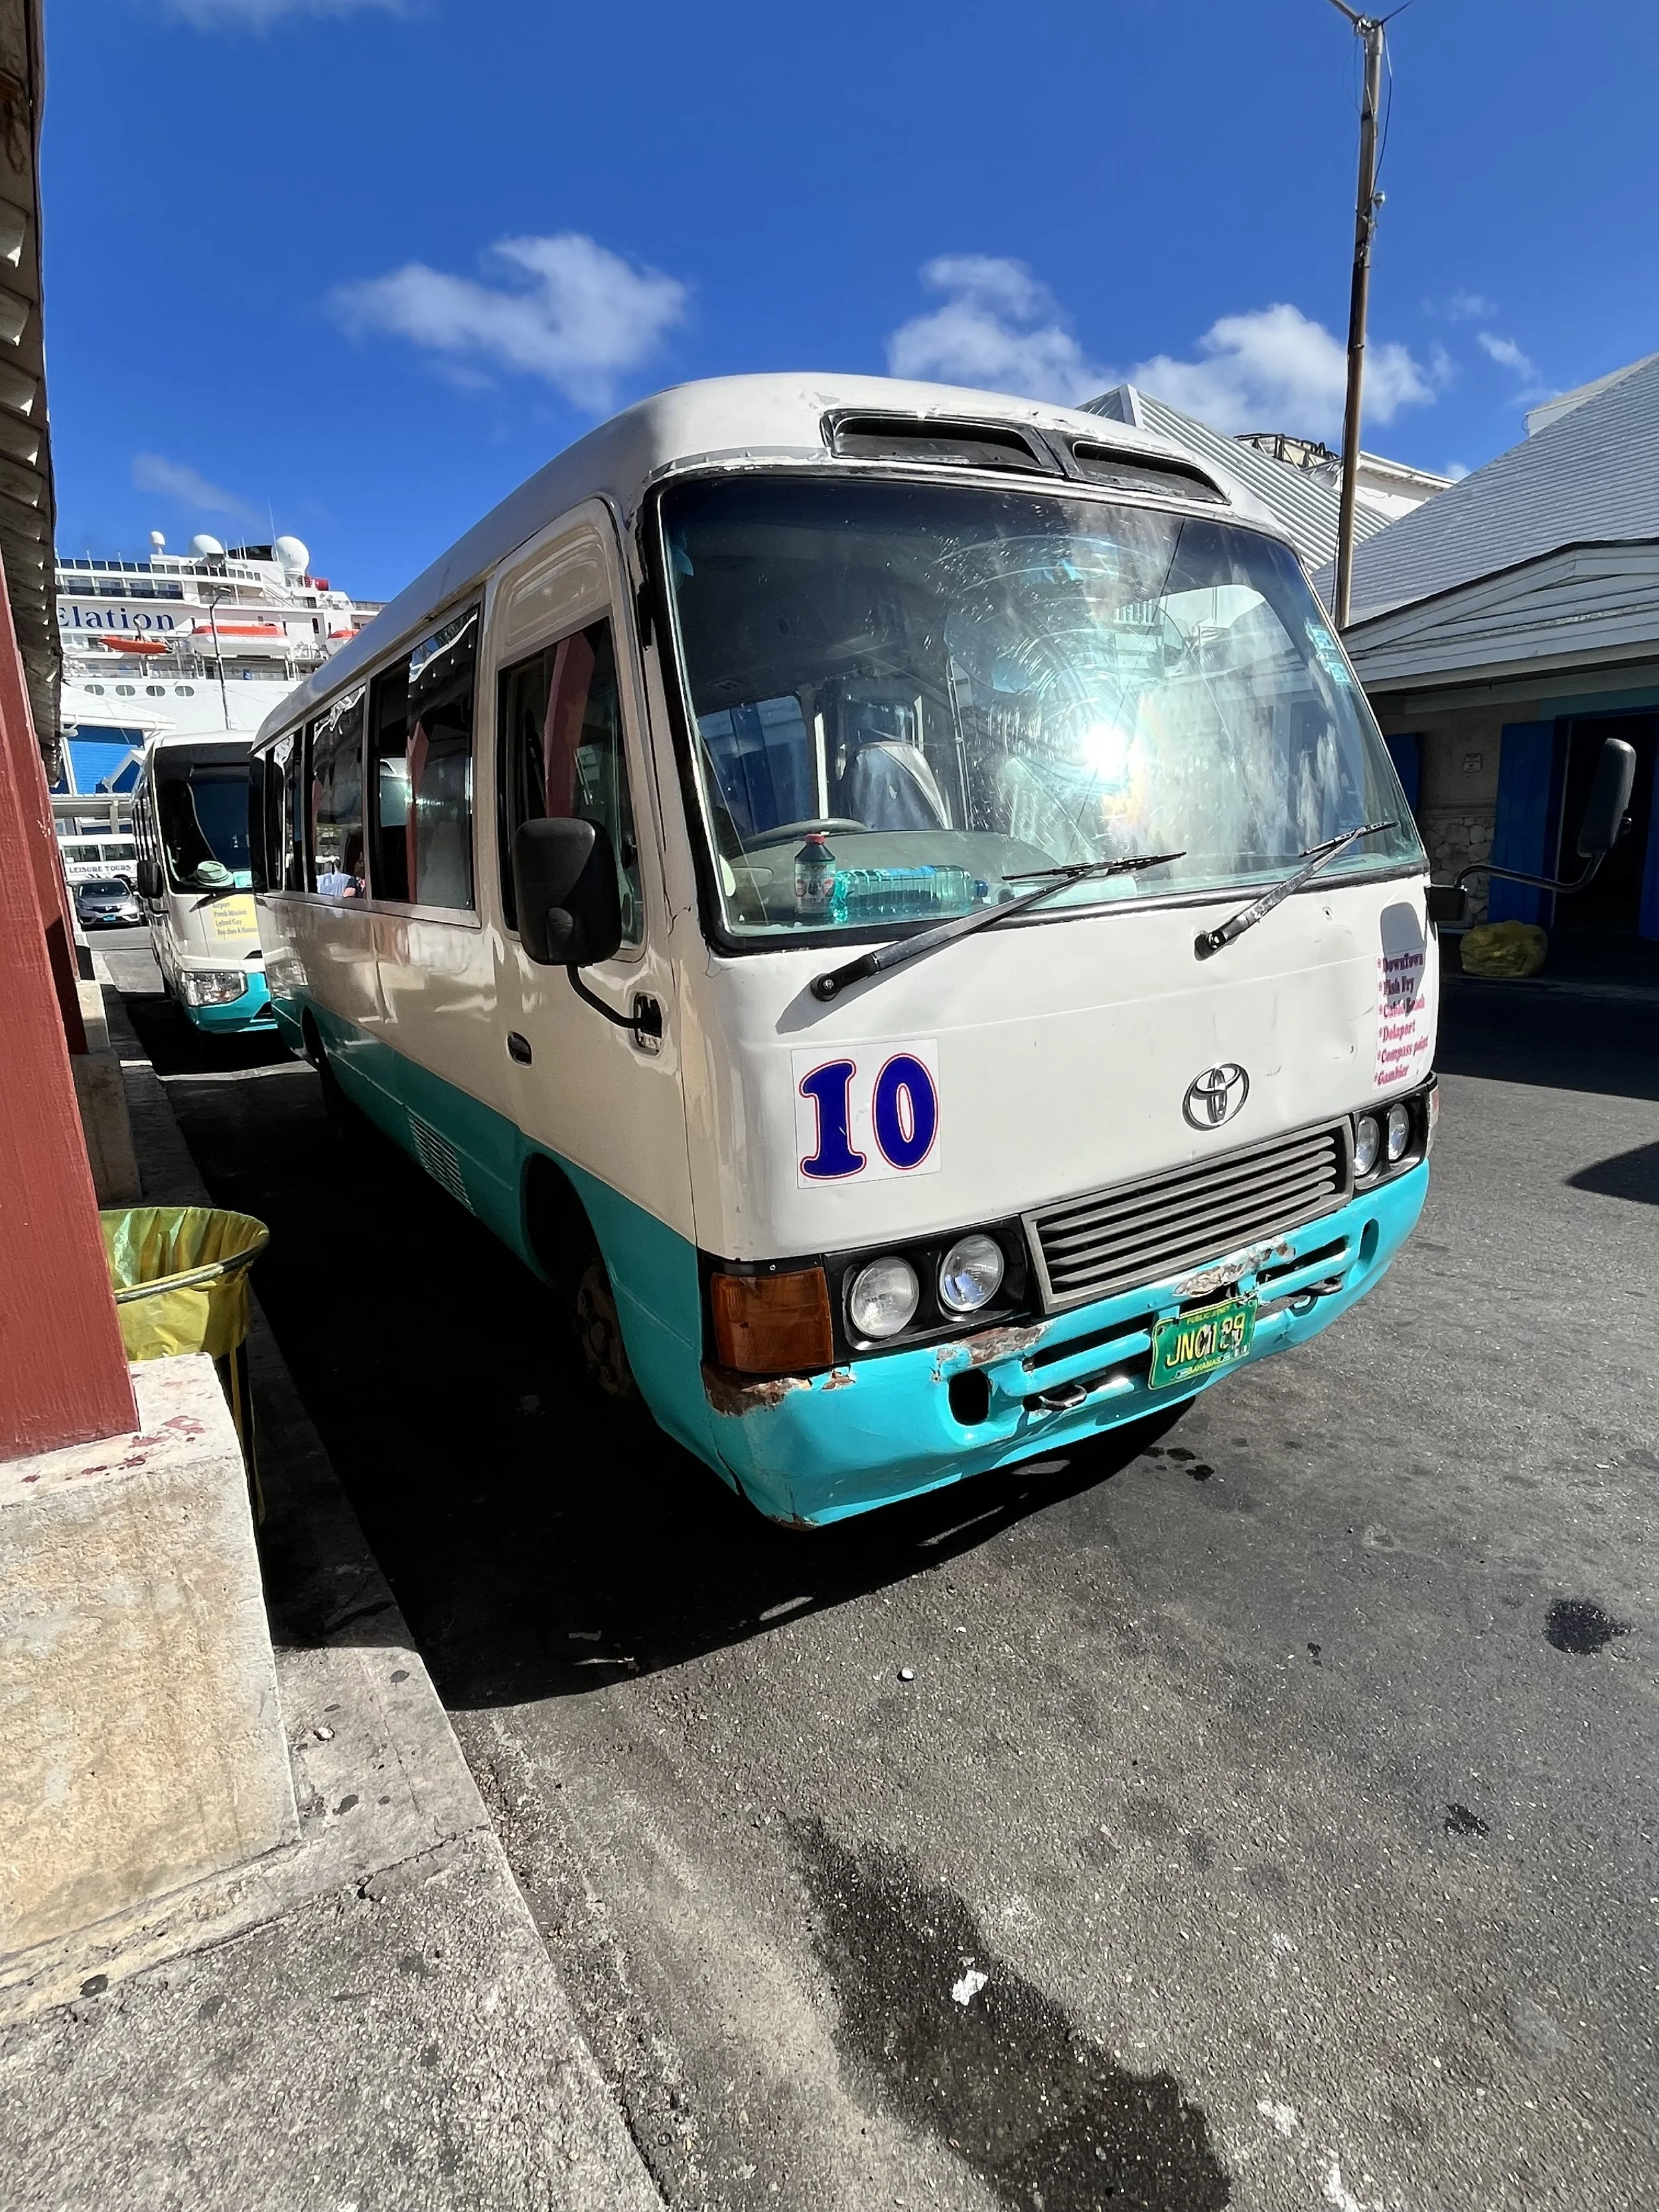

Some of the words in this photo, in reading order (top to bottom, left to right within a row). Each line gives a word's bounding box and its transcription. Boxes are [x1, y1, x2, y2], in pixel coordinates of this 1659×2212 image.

[58, 605, 175, 630] Elation
[1402, 976, 1414, 994] Fry
[1382, 1043, 1412, 1065] Compass
[798, 1053, 939, 1181] 10
